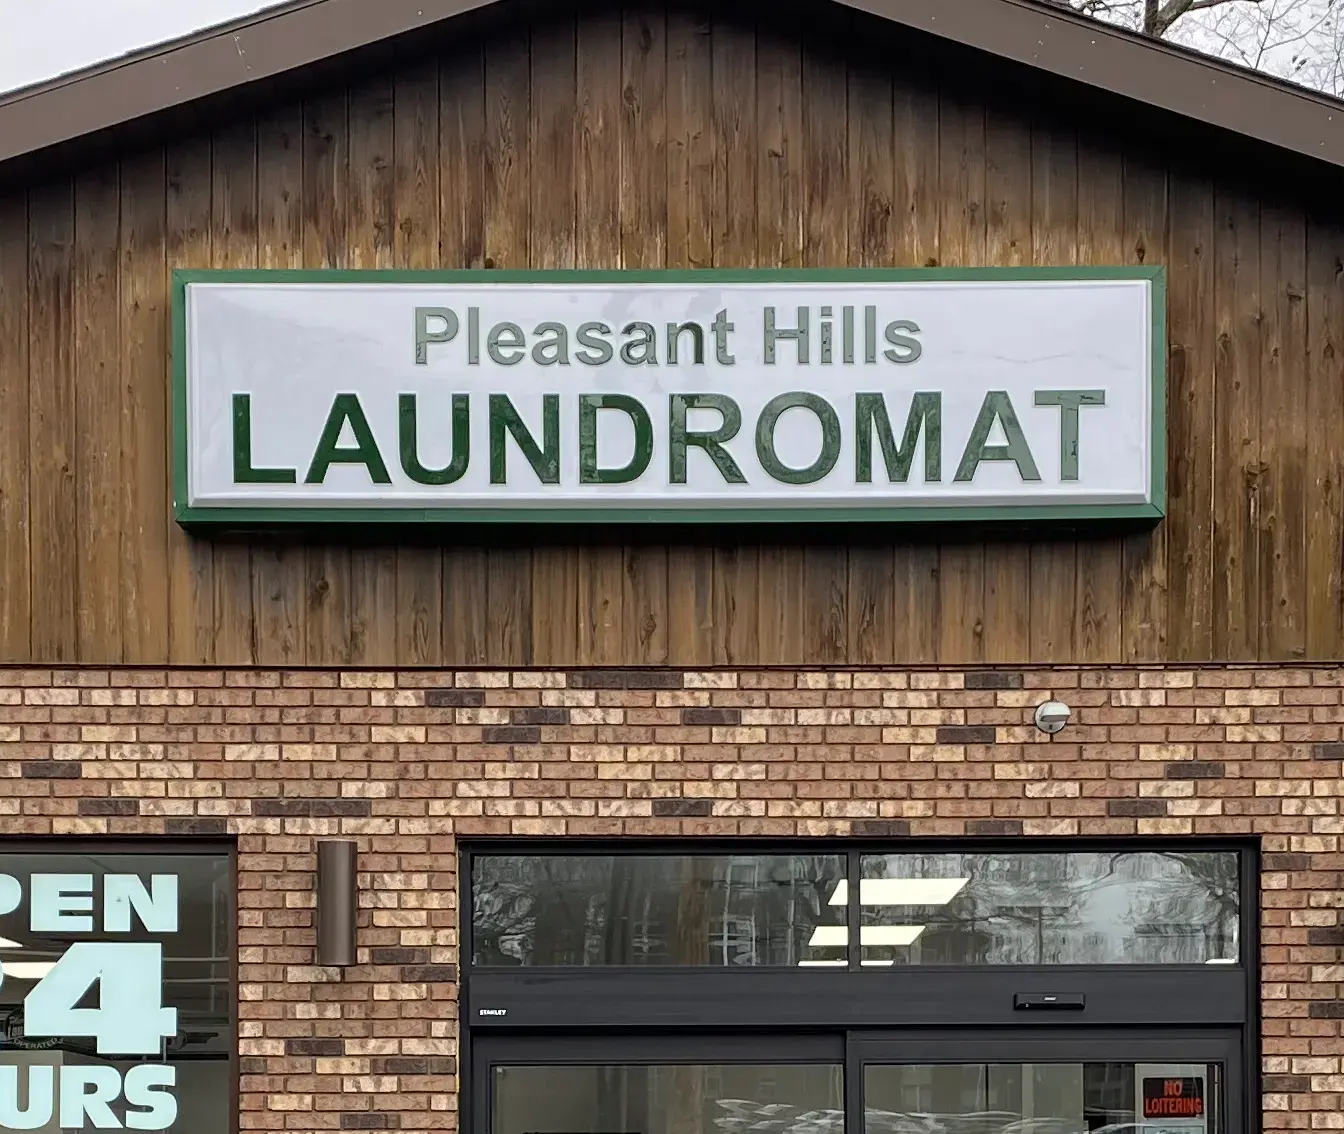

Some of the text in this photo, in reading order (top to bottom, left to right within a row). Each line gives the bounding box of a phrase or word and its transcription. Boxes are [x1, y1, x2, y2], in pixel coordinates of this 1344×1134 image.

[414, 305, 924, 367] Pleasant Hills
[231, 388, 1106, 487] LAUNDROMAT
[1145, 1098, 1202, 1114] LOITERING
[1163, 1080, 1183, 1096] NO
